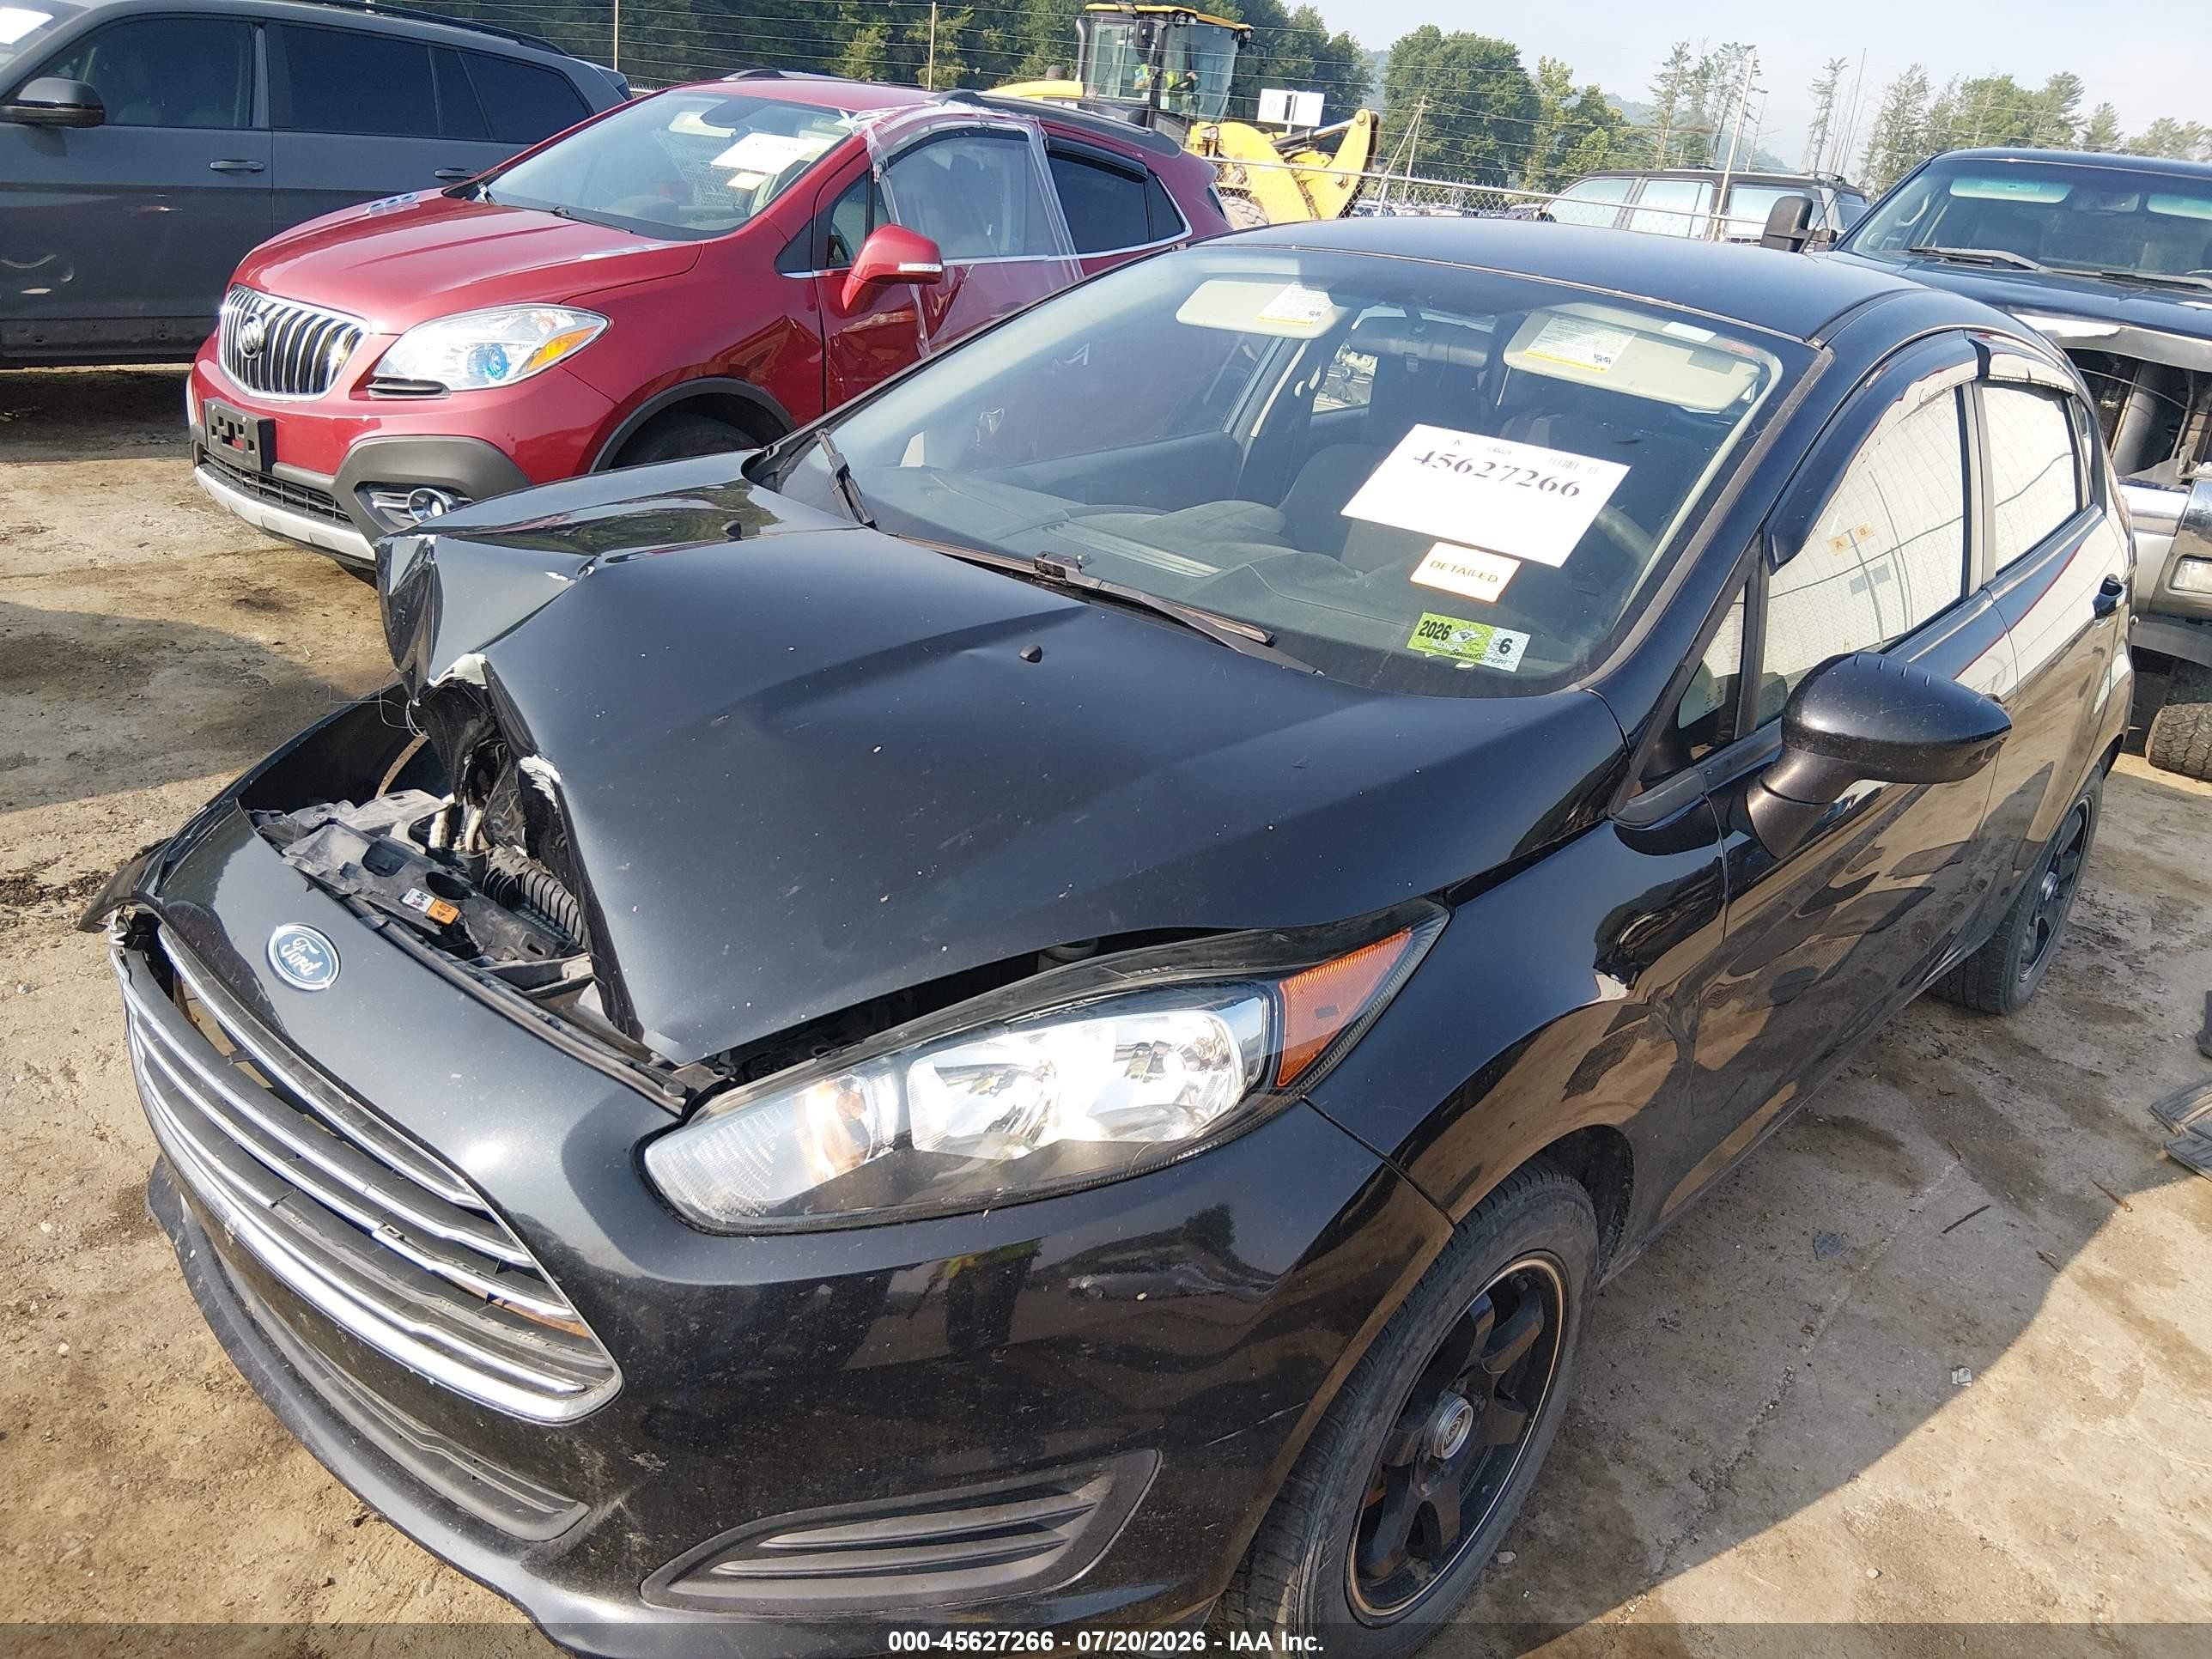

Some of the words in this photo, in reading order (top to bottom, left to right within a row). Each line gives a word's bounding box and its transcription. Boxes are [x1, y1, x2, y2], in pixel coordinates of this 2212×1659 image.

[1413, 451, 1581, 497] 45627266
[1430, 560, 1498, 583] DETAILED
[1418, 620, 1453, 641] 2026
[1498, 637, 1513, 654] 6
[281, 937, 324, 976] Ford
